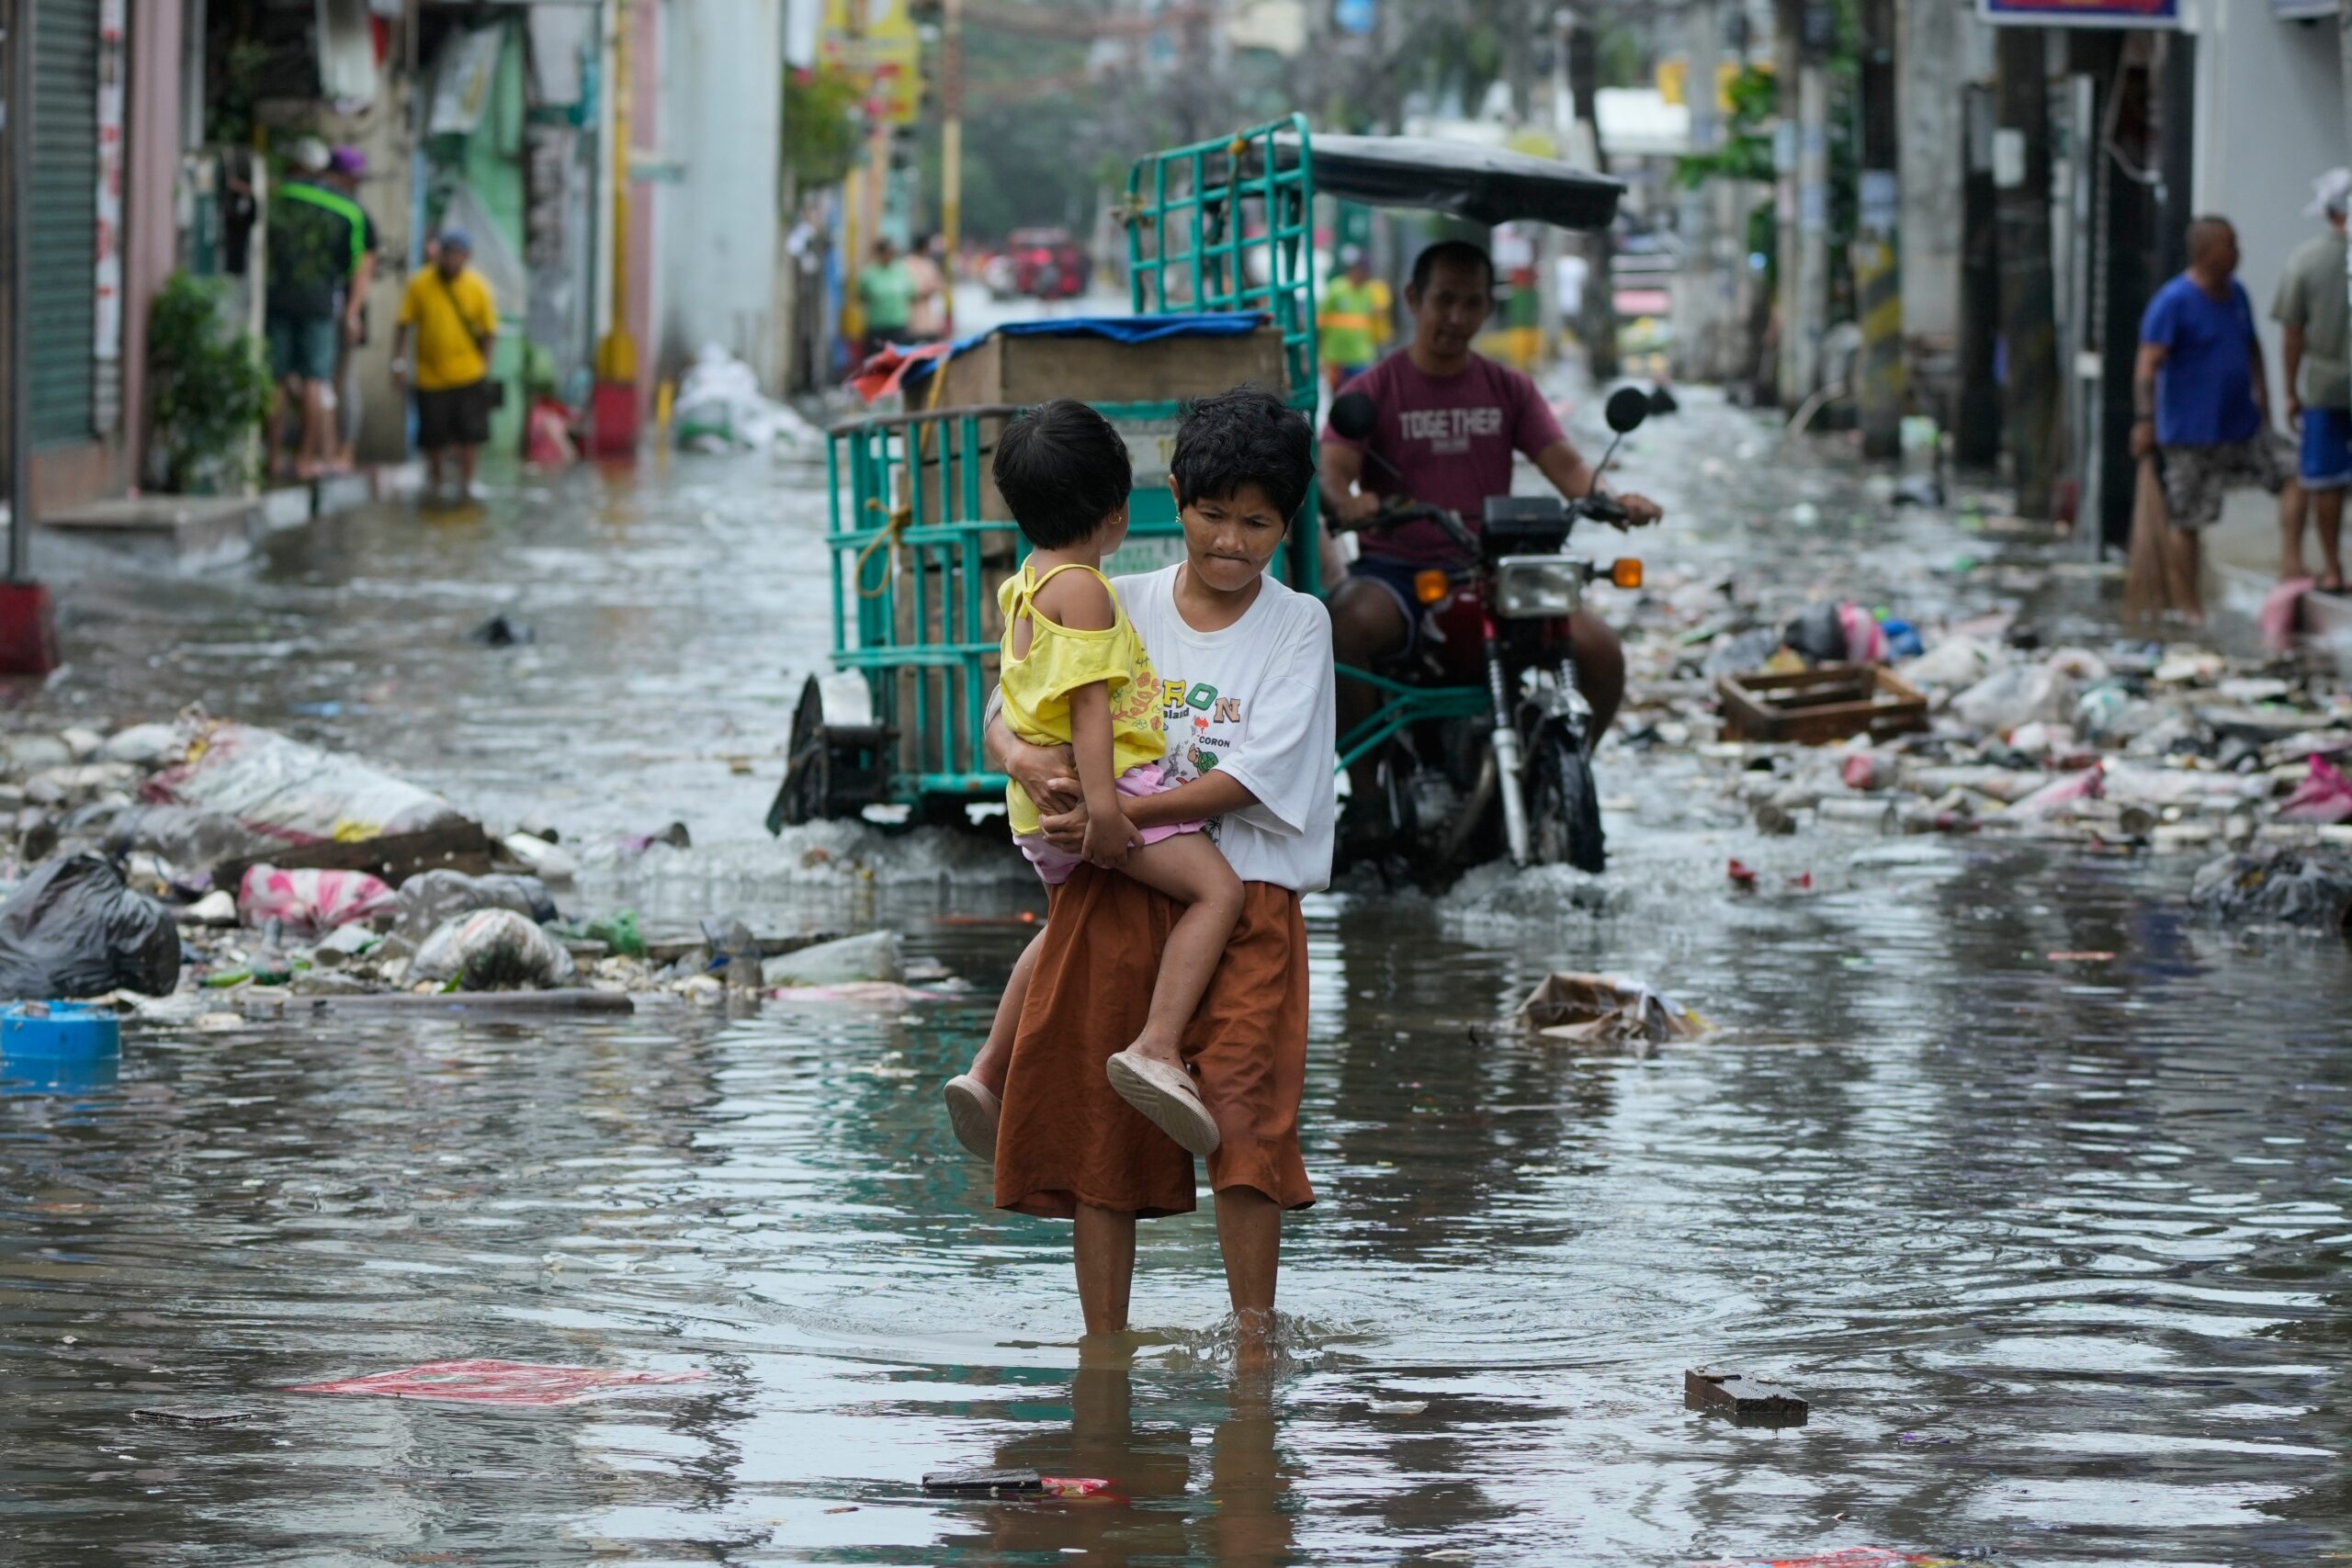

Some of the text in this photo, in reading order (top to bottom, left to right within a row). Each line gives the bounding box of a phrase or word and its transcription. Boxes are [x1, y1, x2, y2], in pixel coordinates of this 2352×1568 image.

[1399, 408, 1502, 440] TOGETHER
[1162, 679, 1240, 724] RON
[1163, 707, 1190, 719] sland
[1199, 736, 1230, 748] CORON
